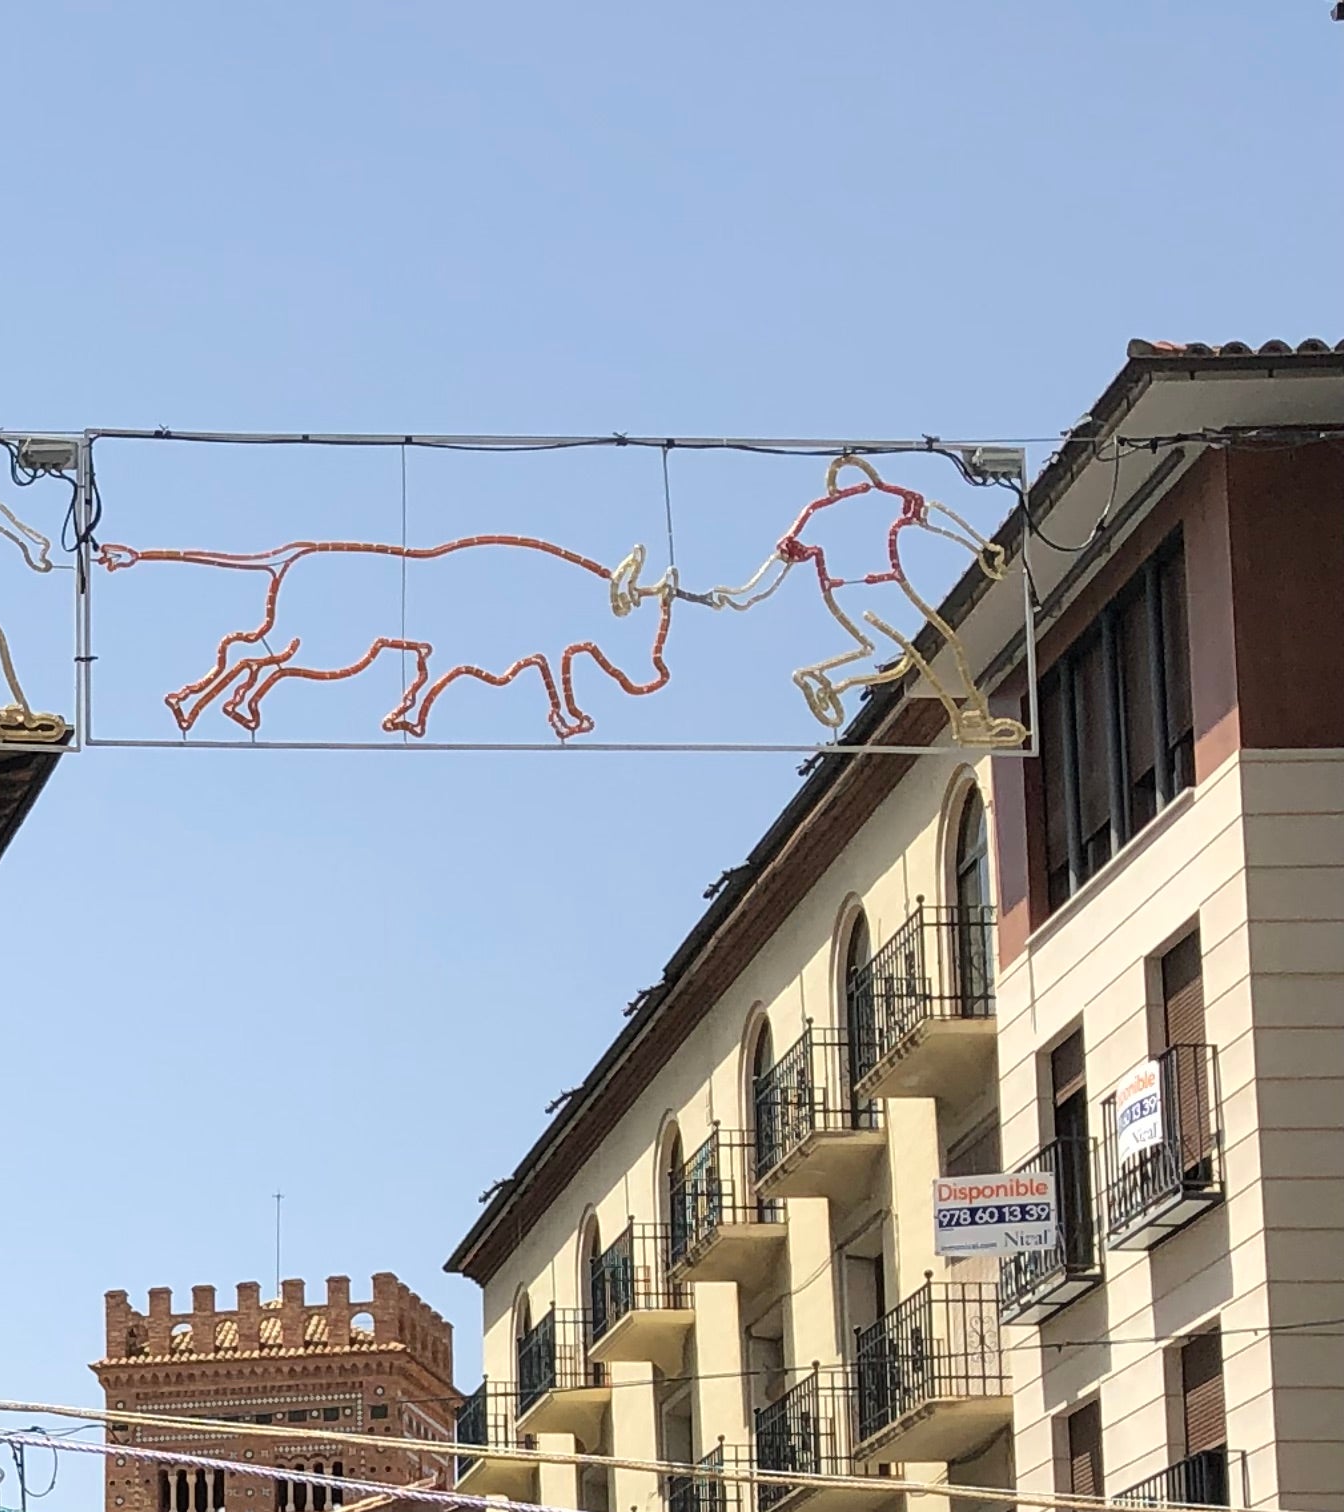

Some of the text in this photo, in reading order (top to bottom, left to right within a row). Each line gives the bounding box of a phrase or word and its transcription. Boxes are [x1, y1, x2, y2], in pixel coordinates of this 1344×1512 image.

[937, 1178, 1049, 1204] Disponible
[938, 1204, 1050, 1226] 978 60 13 39
